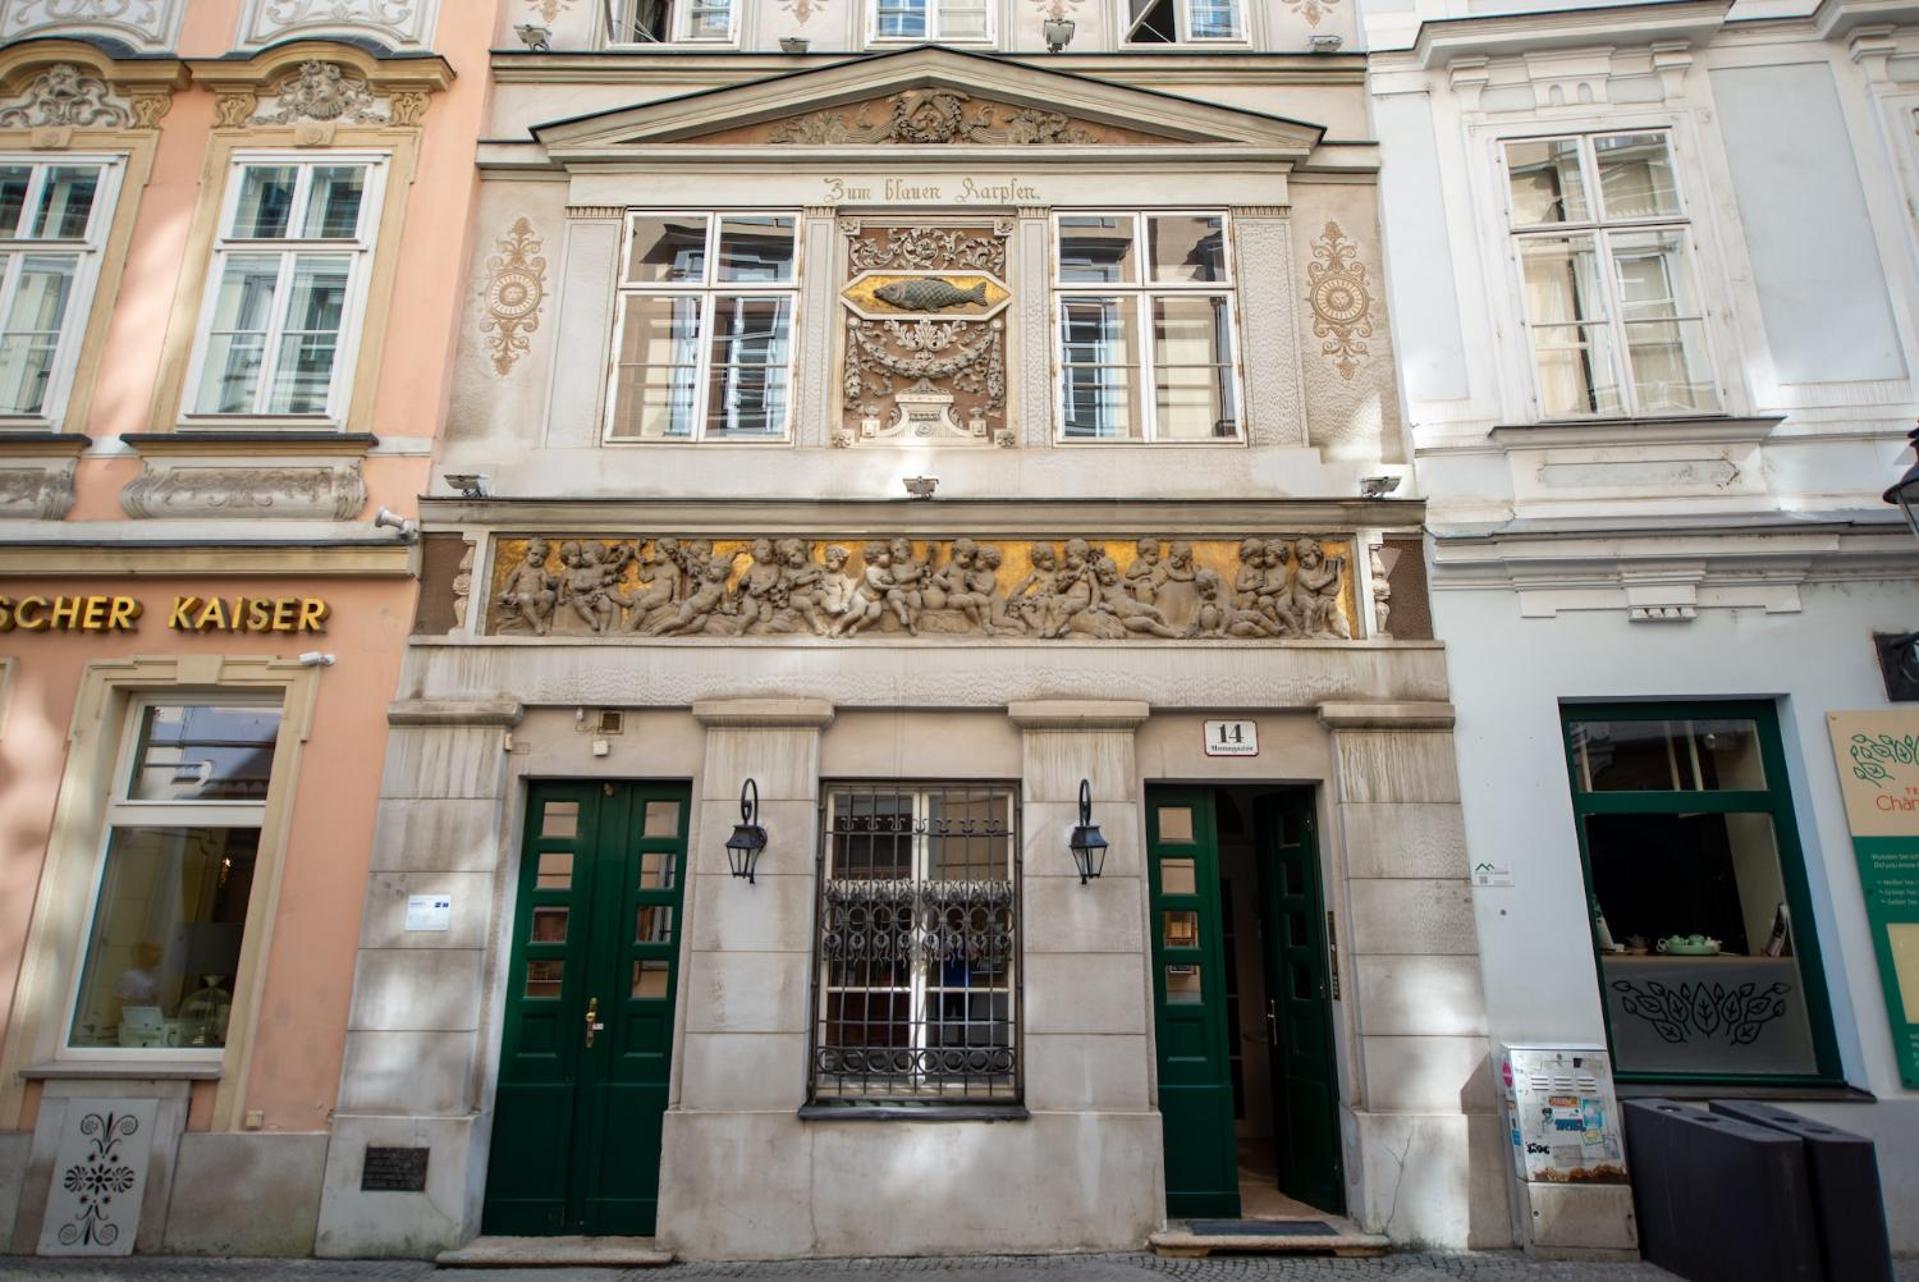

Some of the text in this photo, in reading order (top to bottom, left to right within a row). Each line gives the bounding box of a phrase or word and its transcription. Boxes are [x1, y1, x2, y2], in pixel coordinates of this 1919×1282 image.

[823, 177, 871, 202] Zum
[885, 179, 941, 200] blauen
[167, 595, 330, 633] KAISER
[1218, 724, 1245, 743] 14
